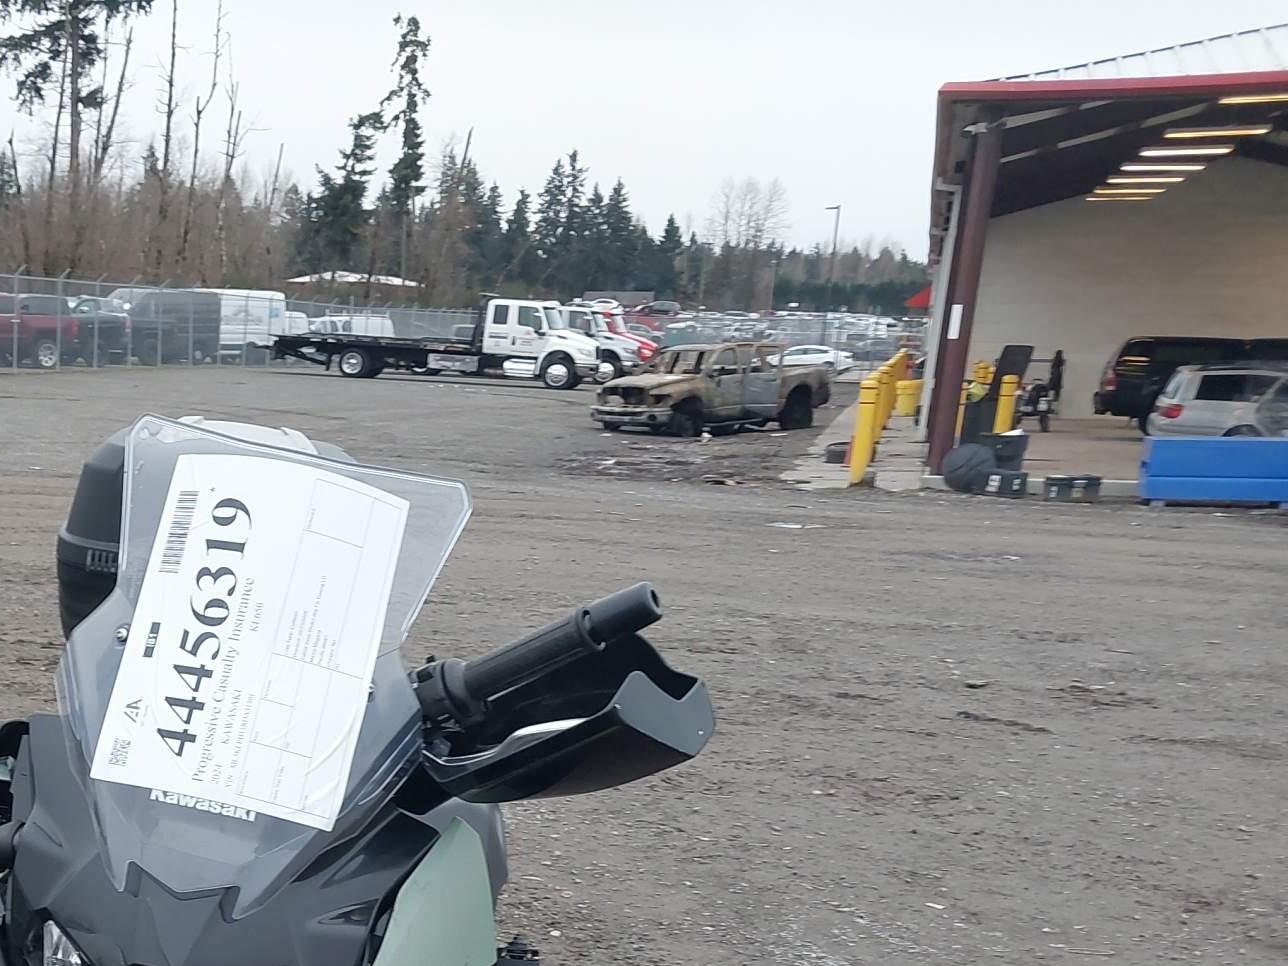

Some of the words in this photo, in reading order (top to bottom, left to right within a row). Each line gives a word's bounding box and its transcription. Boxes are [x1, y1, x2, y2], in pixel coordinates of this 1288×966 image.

[156, 497, 253, 757] 44456319
[191, 706, 221, 782] Progressive
[213, 645, 239, 703] Casualty
[227, 577, 254, 641] Insurance
[220, 689, 242, 745] KAWASAKI
